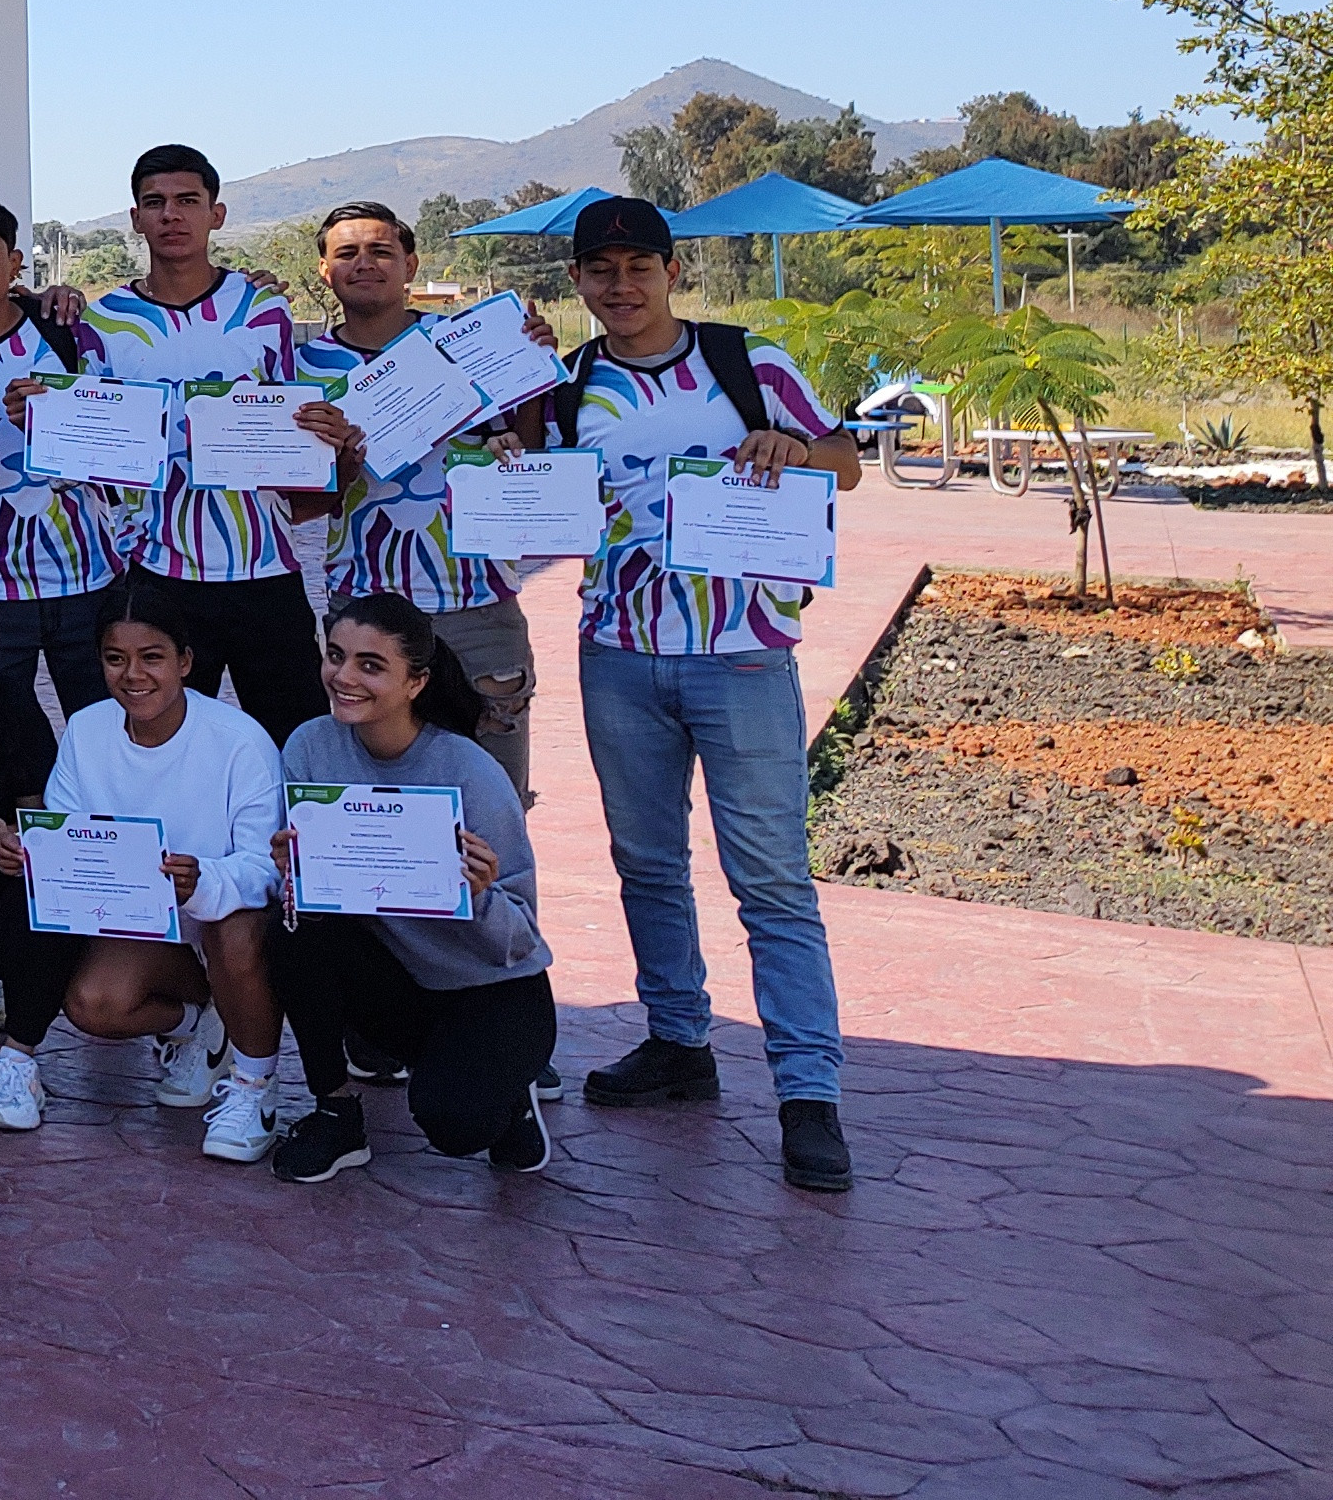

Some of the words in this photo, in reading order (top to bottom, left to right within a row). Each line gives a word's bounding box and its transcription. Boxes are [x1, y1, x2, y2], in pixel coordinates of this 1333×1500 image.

[354, 360, 396, 392] CUTLAJO
[74, 389, 123, 402] CUTLAJO
[232, 394, 285, 404] CUTLAJO
[497, 462, 552, 473] CUTLAJO
[343, 801, 404, 814] CUTLAJO
[67, 829, 118, 841] CUTLAJO
